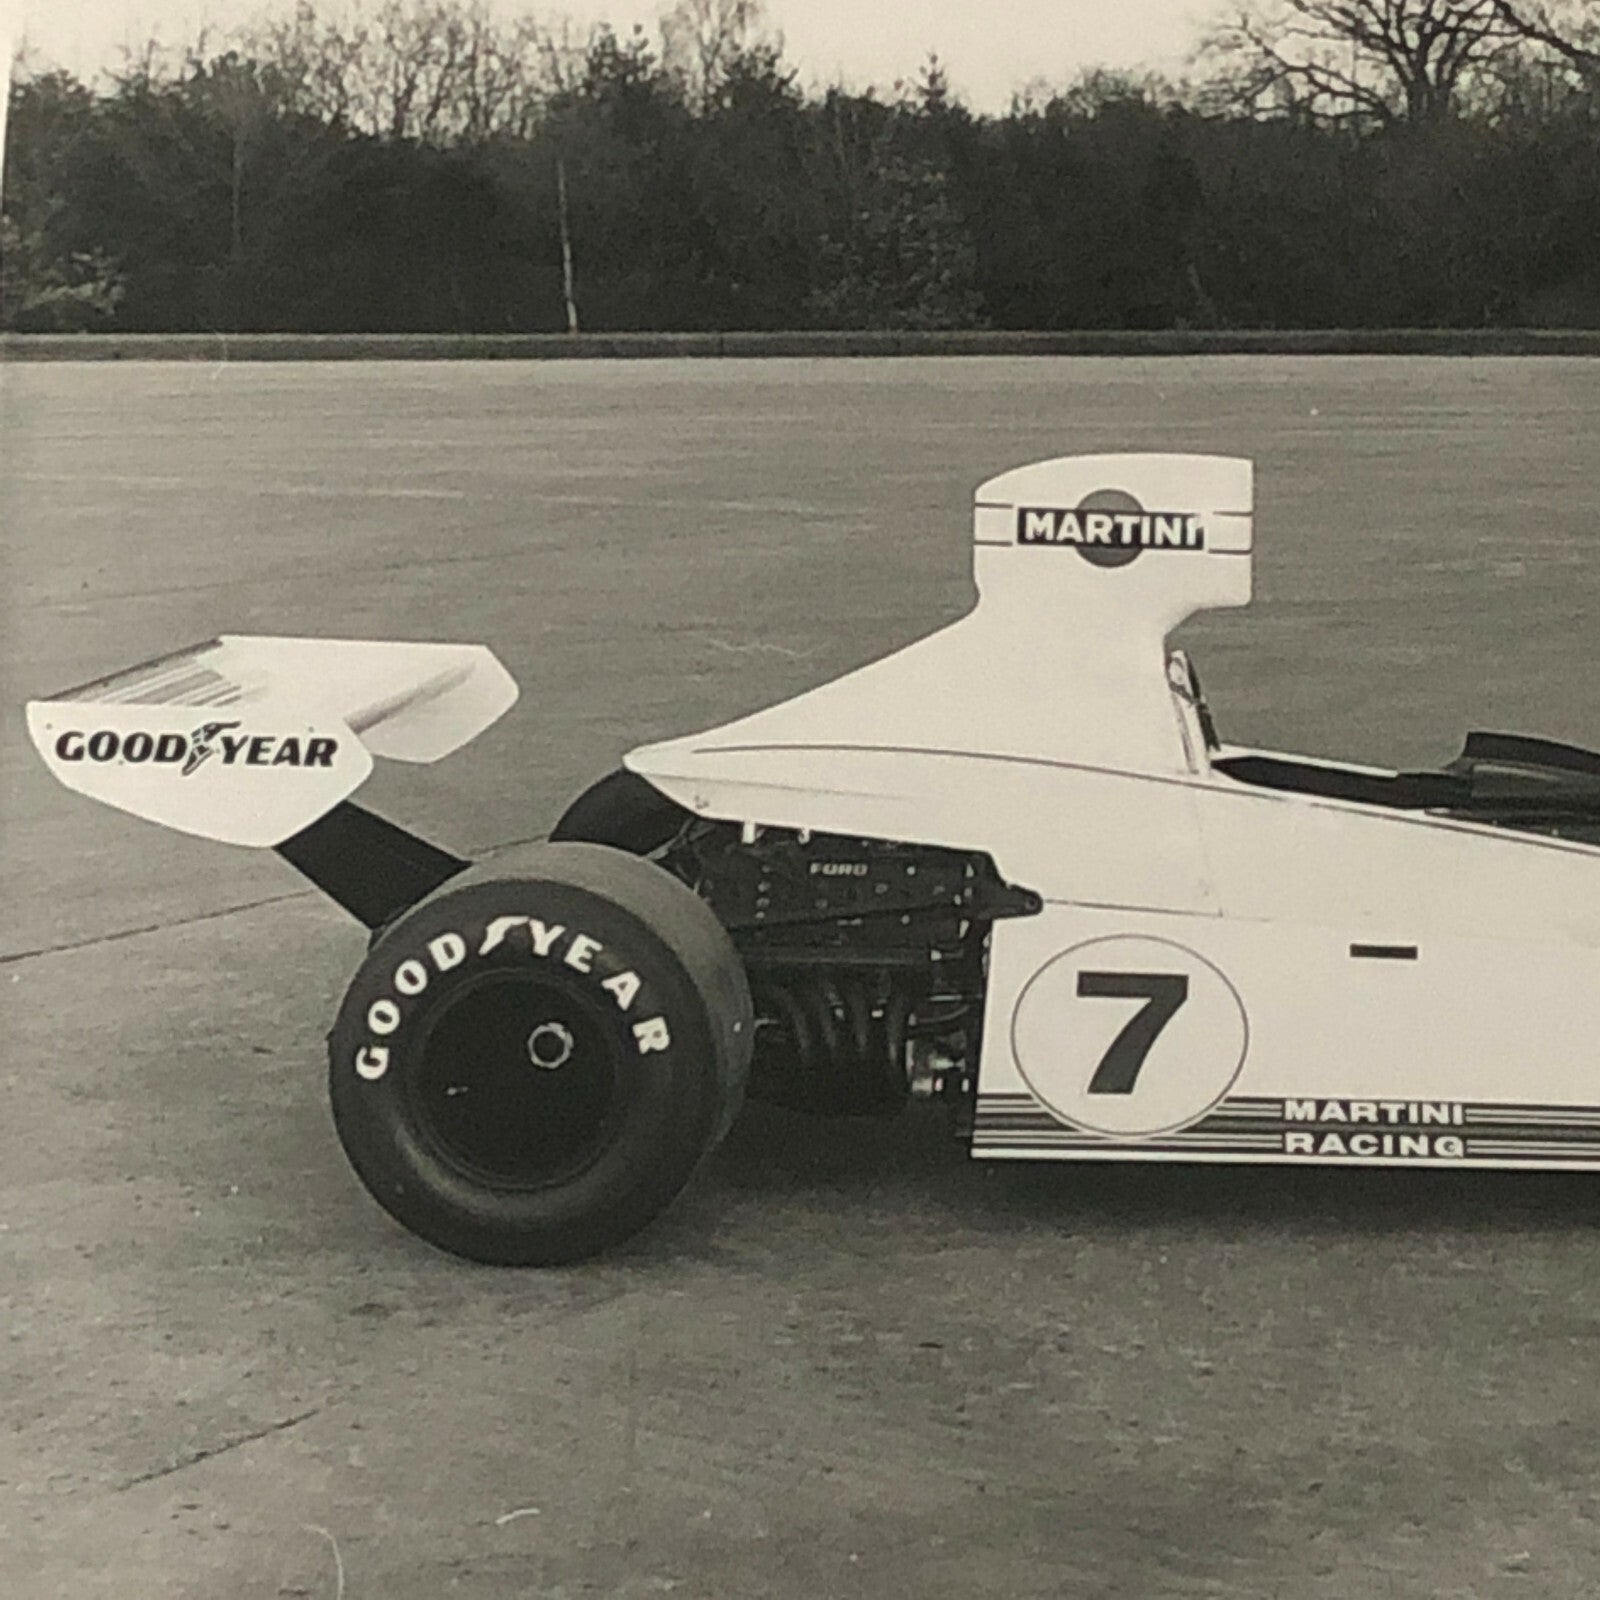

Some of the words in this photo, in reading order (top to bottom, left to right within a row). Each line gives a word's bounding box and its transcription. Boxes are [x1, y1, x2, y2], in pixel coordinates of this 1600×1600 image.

[1025, 511, 1198, 546] MARTINI
[55, 725, 339, 772] GOODYEAR
[355, 915, 670, 1080] GOODYEAR
[1076, 970, 1189, 1094] 7
[1284, 1099, 1464, 1125] MARTINI
[1284, 1131, 1464, 1157] RACING
